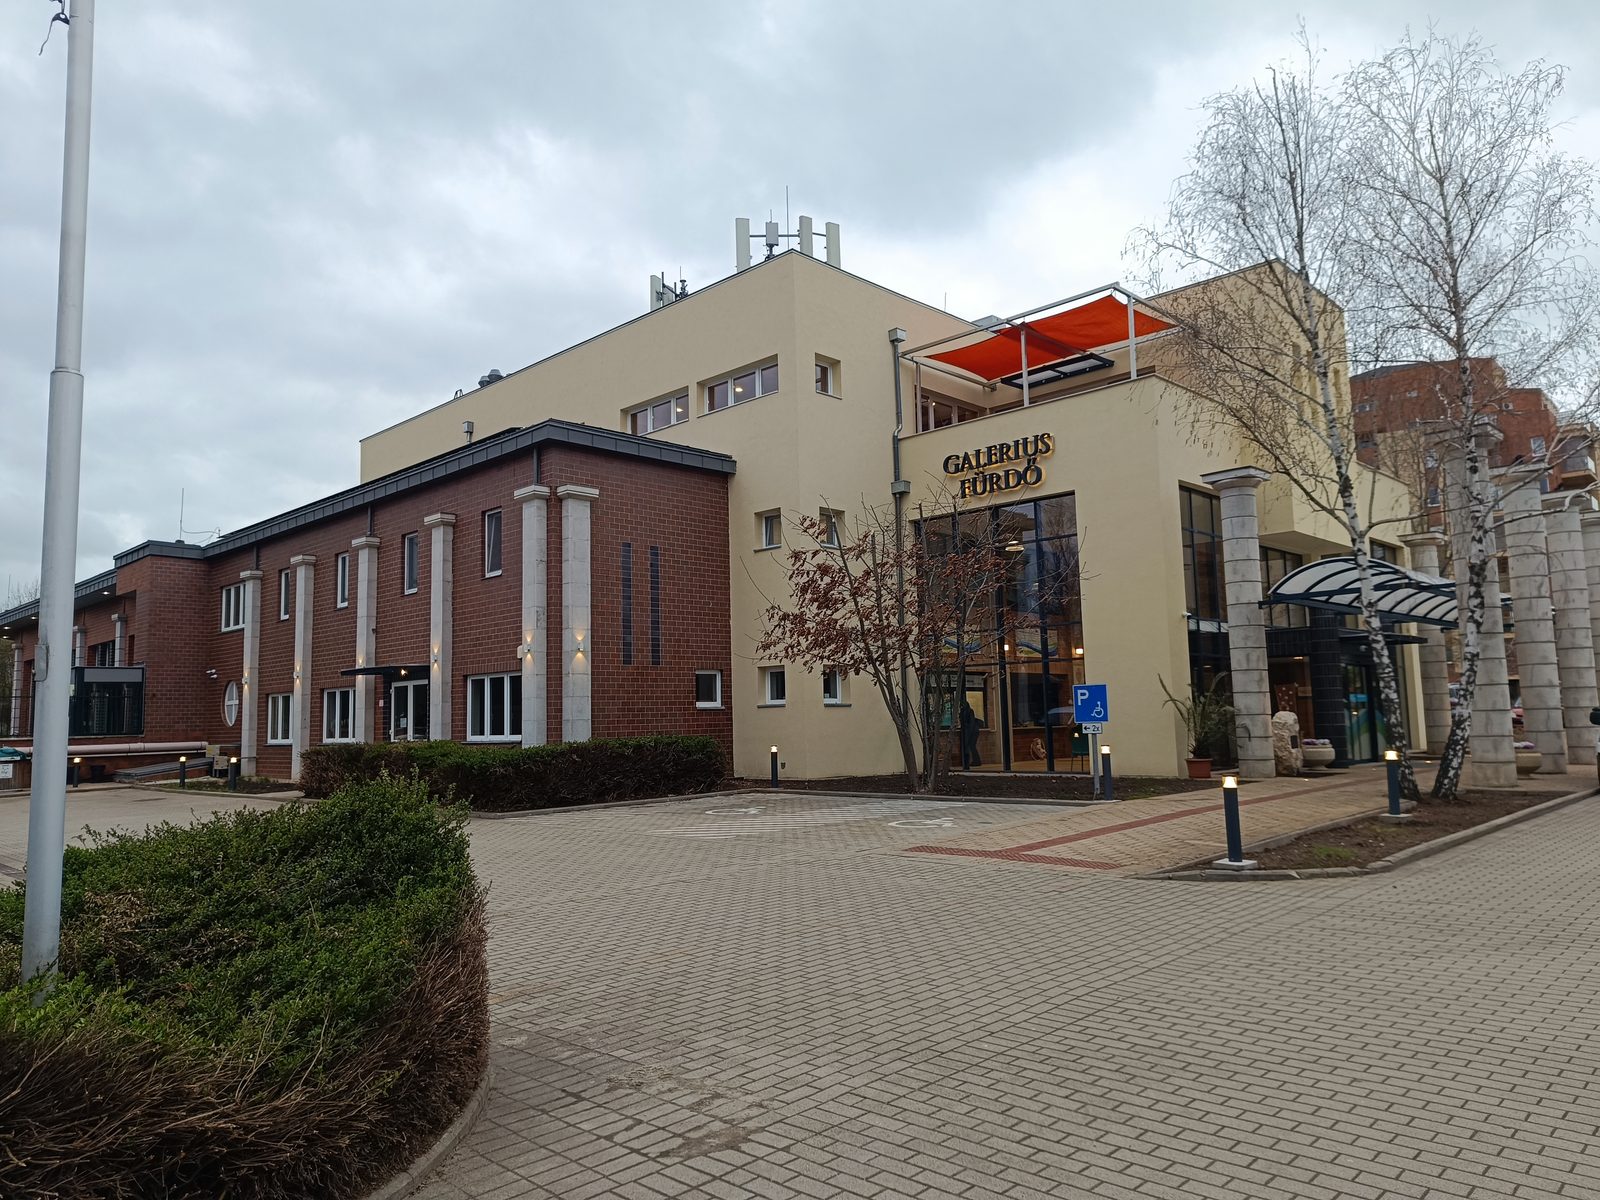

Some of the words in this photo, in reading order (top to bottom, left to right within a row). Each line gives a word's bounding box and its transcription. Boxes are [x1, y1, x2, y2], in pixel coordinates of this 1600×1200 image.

[943, 432, 1051, 475] GALERIUS
[959, 457, 1043, 499] FÜRDŐ
[1077, 689, 1089, 706] P
